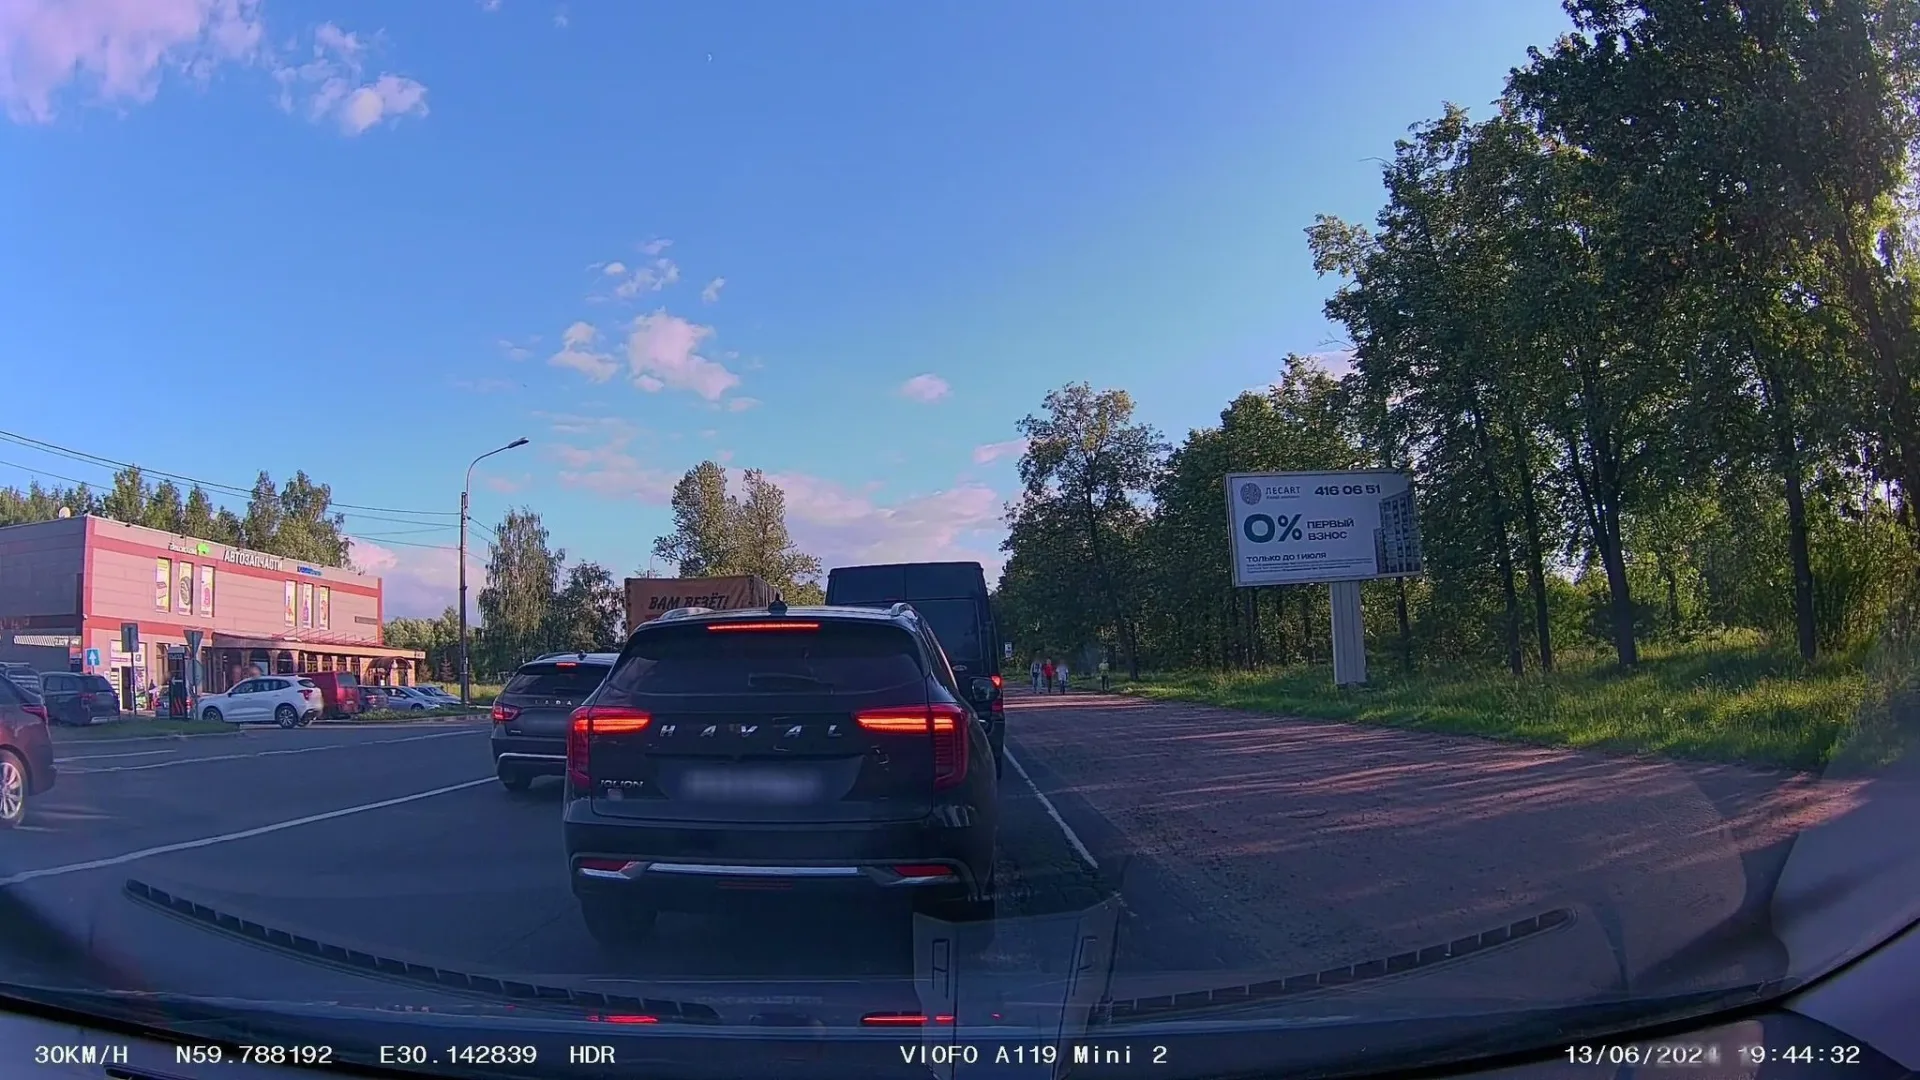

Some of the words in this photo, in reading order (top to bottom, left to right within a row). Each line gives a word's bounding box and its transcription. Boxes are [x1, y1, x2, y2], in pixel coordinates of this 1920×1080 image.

[1314, 485, 1339, 495] 416
[1342, 485, 1362, 495] 06
[1365, 484, 1381, 494] 51
[1243, 513, 1302, 544] 0%
[1307, 518, 1354, 529] ПЕРВЫЙ
[1308, 531, 1347, 541] ВЗНОС
[224, 550, 283, 571] АВТОЗАПЧАСТИ
[1246, 555, 1280, 563] ТОЛЬКО
[1282, 554, 1295, 562] ДО
[1301, 552, 1327, 560] ИЮЛЯ
[648, 596, 680, 610] ВАМ
[684, 592, 730, 610] ВЕЗЁТ!
[659, 724, 842, 738] HAVAL
[600, 779, 644, 788] JOLION
